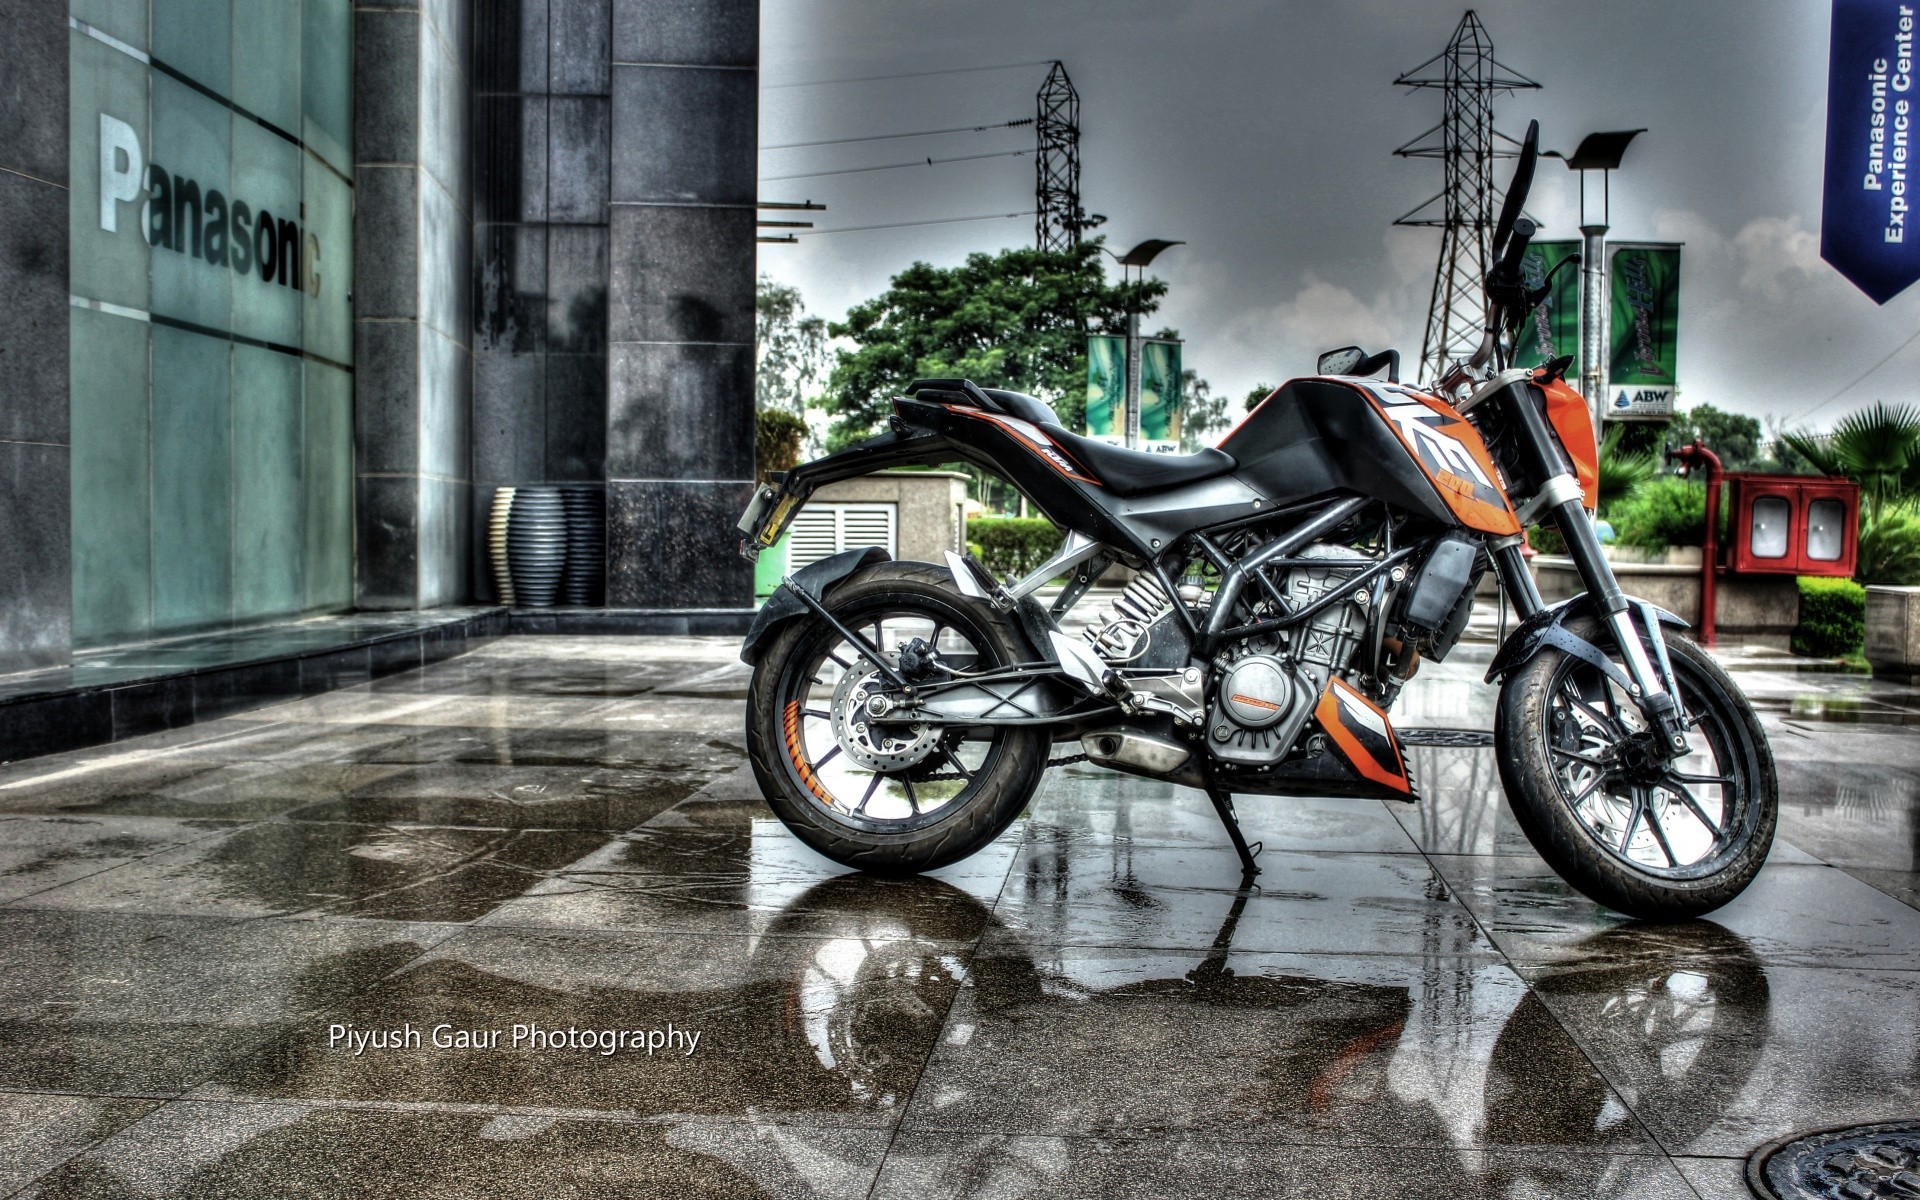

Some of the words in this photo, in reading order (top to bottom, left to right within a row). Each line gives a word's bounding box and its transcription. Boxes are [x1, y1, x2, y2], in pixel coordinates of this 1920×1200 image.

[1891, 5, 1914, 93] Center
[1863, 58, 1888, 191] Panasonic
[100, 112, 321, 299] Panasonic
[1884, 100, 1909, 244] Experience
[1534, 303, 1558, 357] erona
[1632, 389, 1669, 403] ABW
[1040, 448, 1074, 473] KTM
[1155, 444, 1176, 454] ABW
